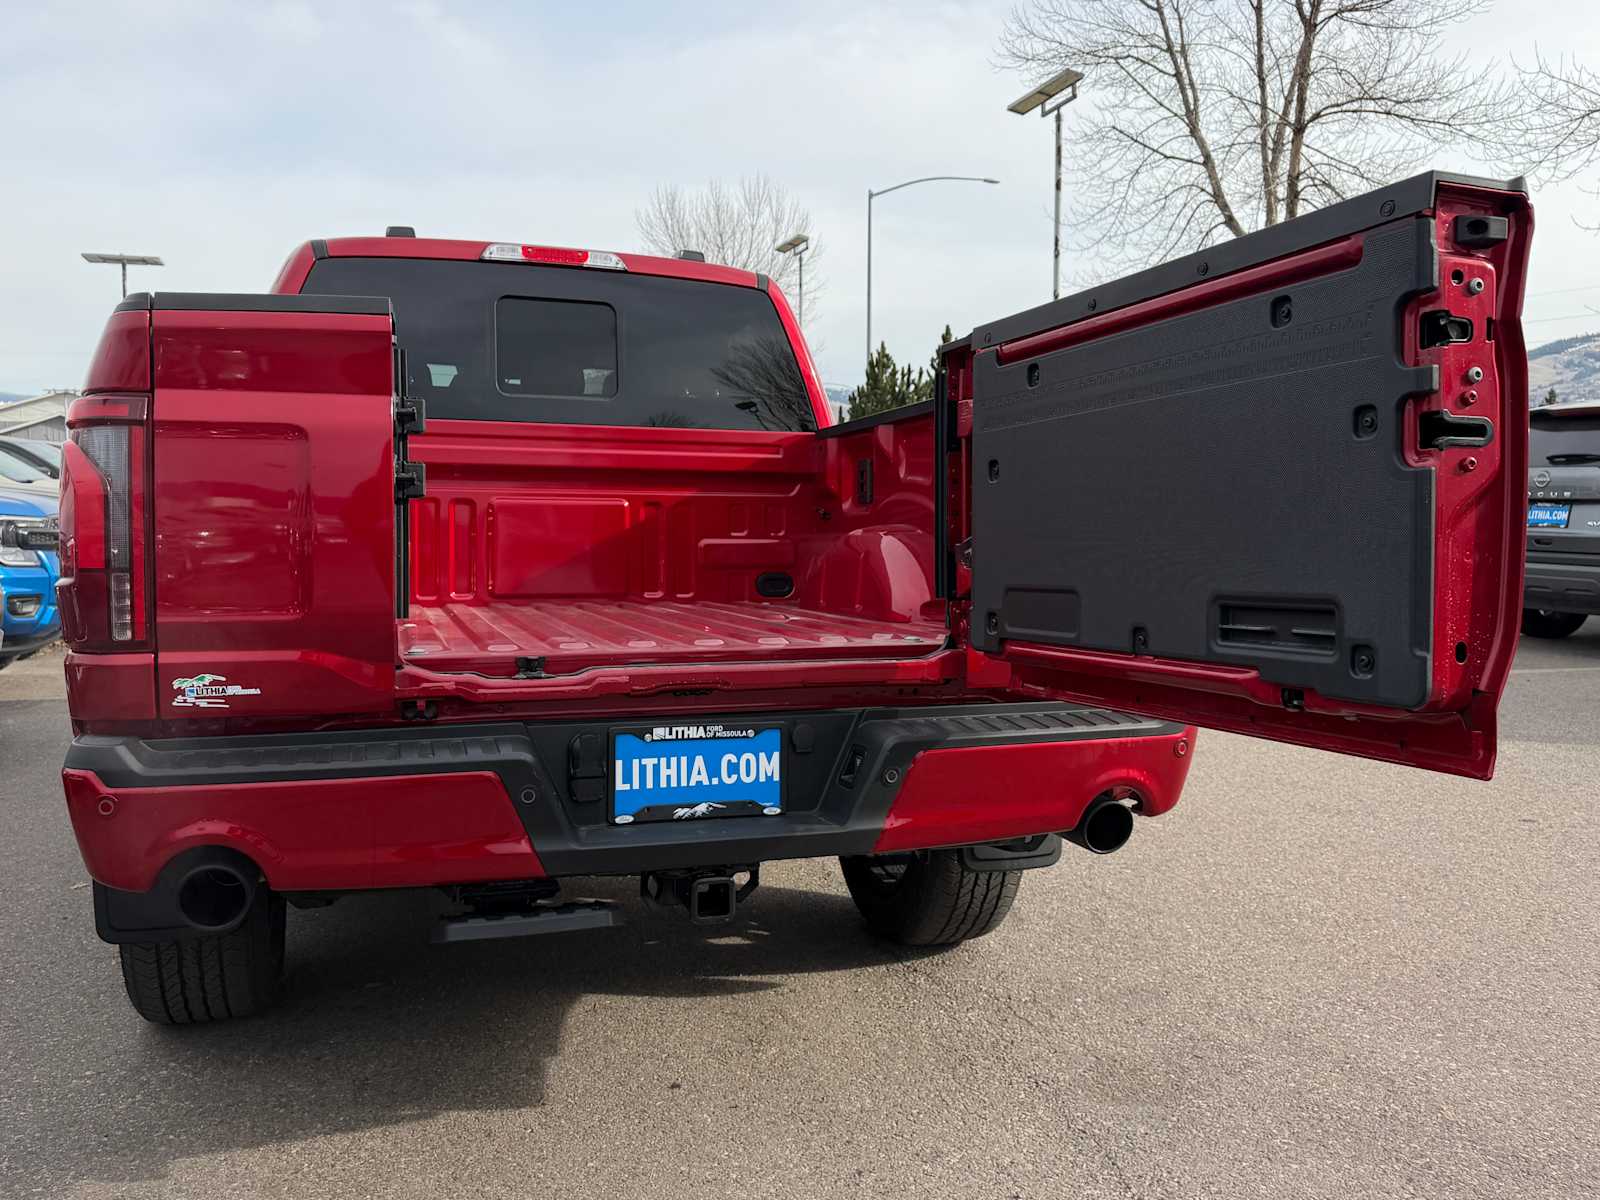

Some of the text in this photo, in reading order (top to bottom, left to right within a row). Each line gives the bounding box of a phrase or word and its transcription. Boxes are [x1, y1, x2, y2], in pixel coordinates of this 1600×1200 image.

[196, 687, 227, 696] LITHIA
[664, 726, 706, 739] LITHIA
[716, 730, 747, 738] MISSOULA
[615, 751, 780, 791] LITHIA.COM
